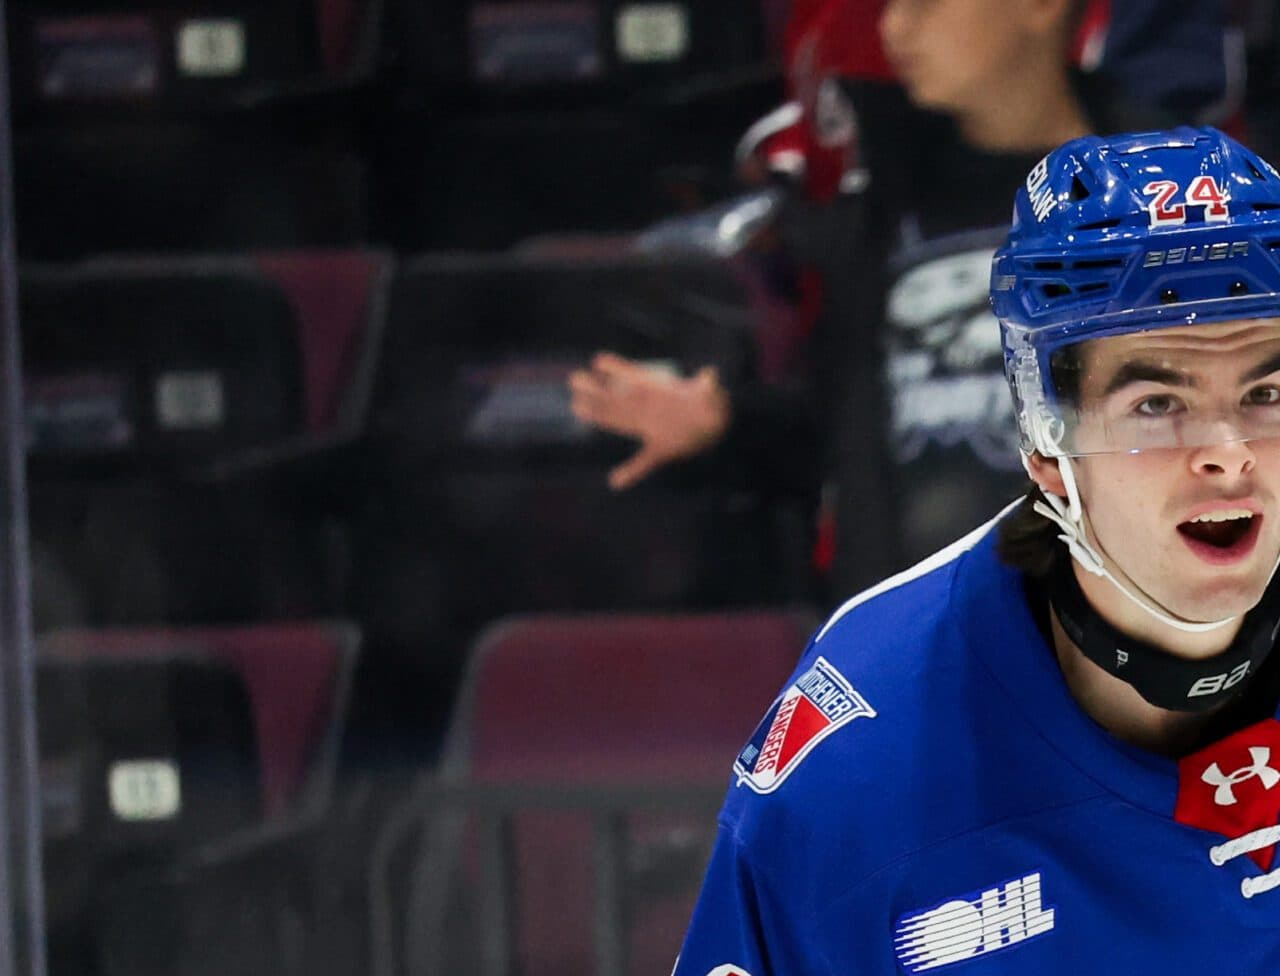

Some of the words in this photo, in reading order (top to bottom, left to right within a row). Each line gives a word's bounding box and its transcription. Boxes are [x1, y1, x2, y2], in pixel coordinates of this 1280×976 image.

[1143, 176, 1232, 229] 24
[754, 696, 800, 775] RANGERS
[894, 872, 1055, 972] OHL
